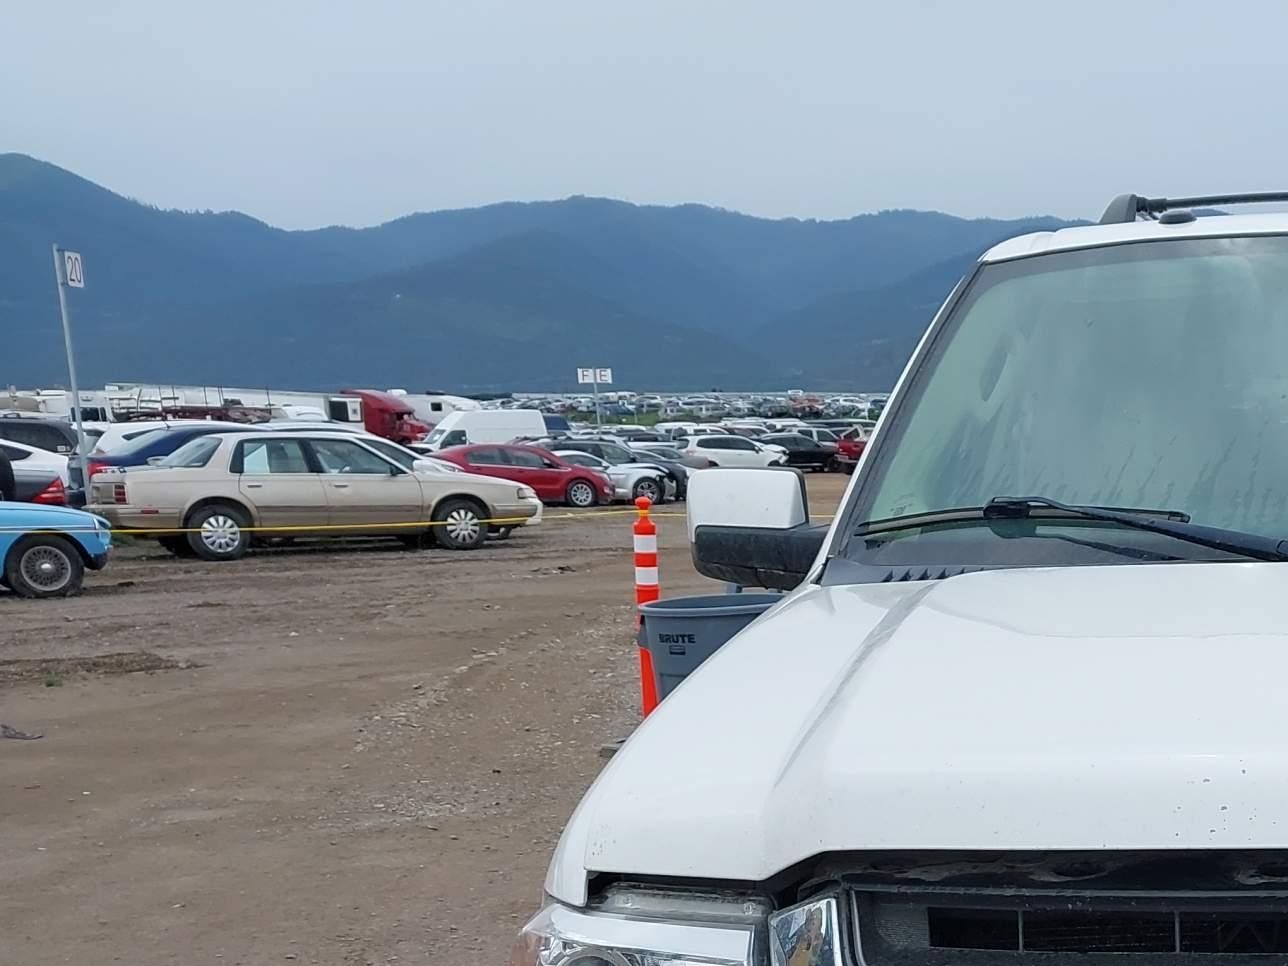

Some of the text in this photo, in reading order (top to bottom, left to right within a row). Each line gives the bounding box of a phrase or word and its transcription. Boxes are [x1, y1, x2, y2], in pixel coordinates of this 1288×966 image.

[67, 255, 82, 284] 20
[581, 369, 590, 382] F
[599, 369, 609, 382] E
[658, 633, 696, 644] BRUTE
